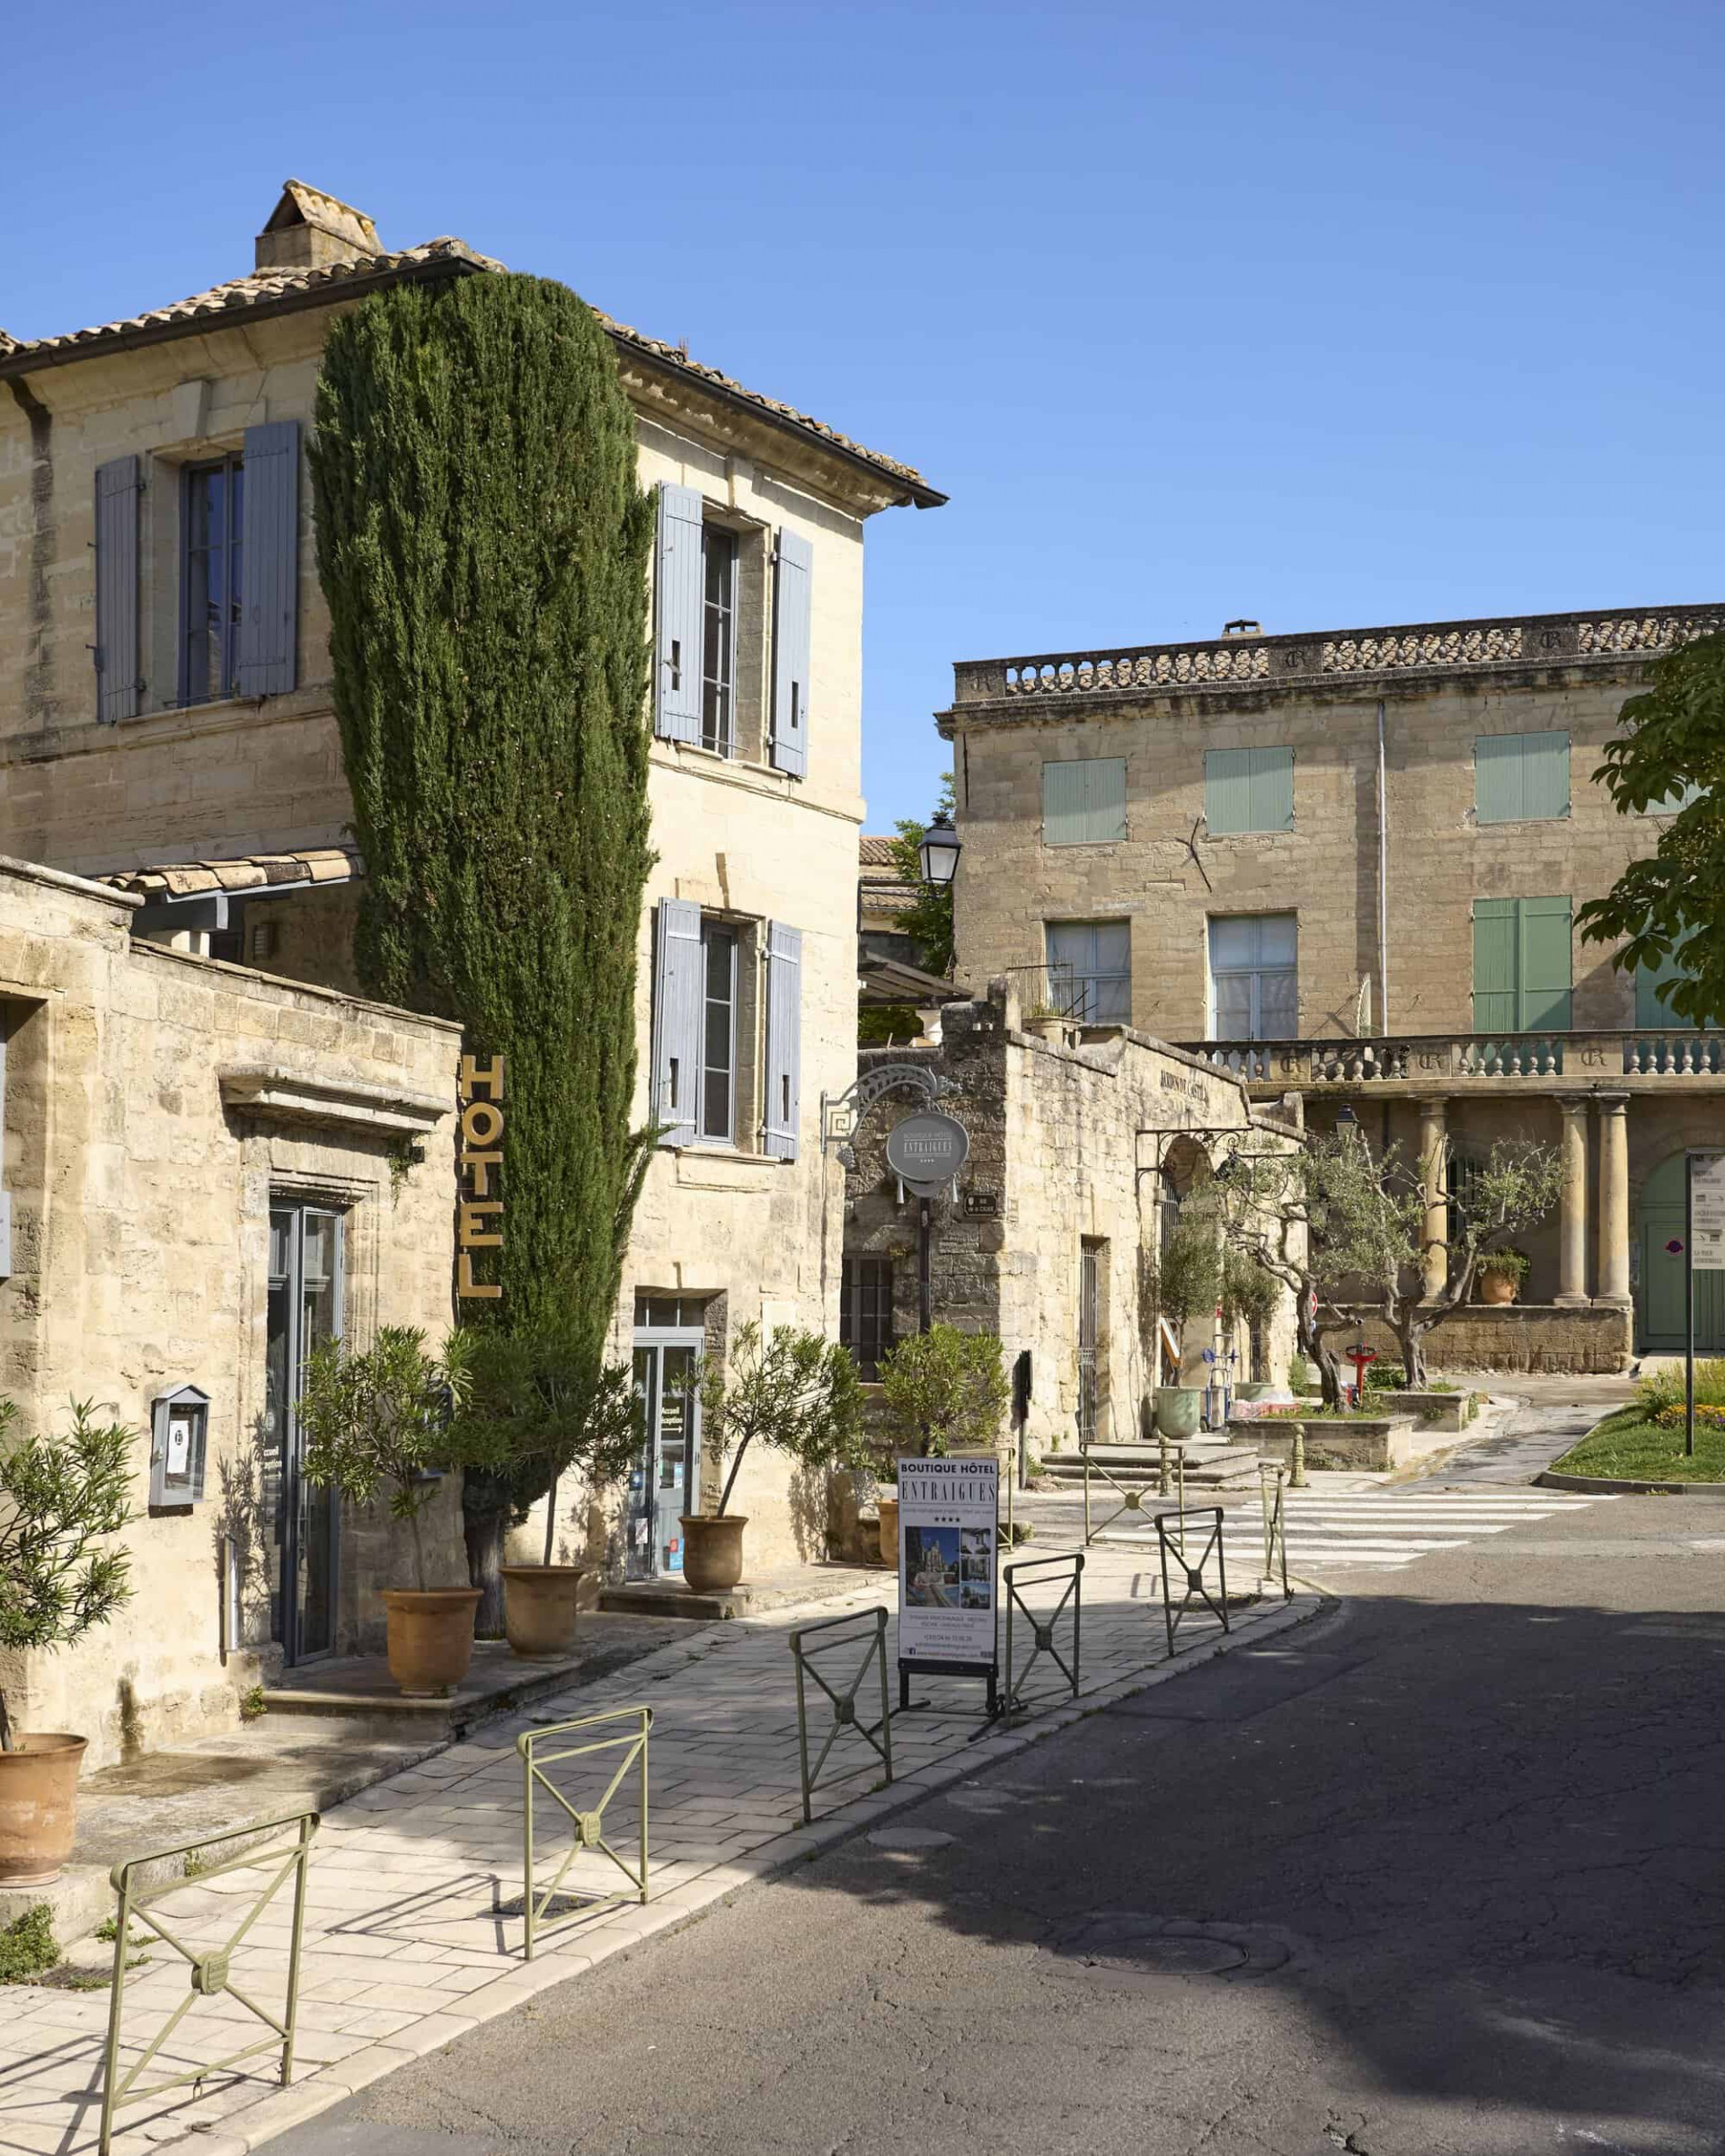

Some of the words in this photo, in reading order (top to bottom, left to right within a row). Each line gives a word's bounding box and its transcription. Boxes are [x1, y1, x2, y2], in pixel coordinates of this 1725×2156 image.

[458, 1055, 505, 1298] HOTEL
[901, 1463, 957, 1473] BOUTIQUE
[960, 1462, 995, 1474] HÔTEL
[902, 1480, 995, 1502] ENTRAIGUES
